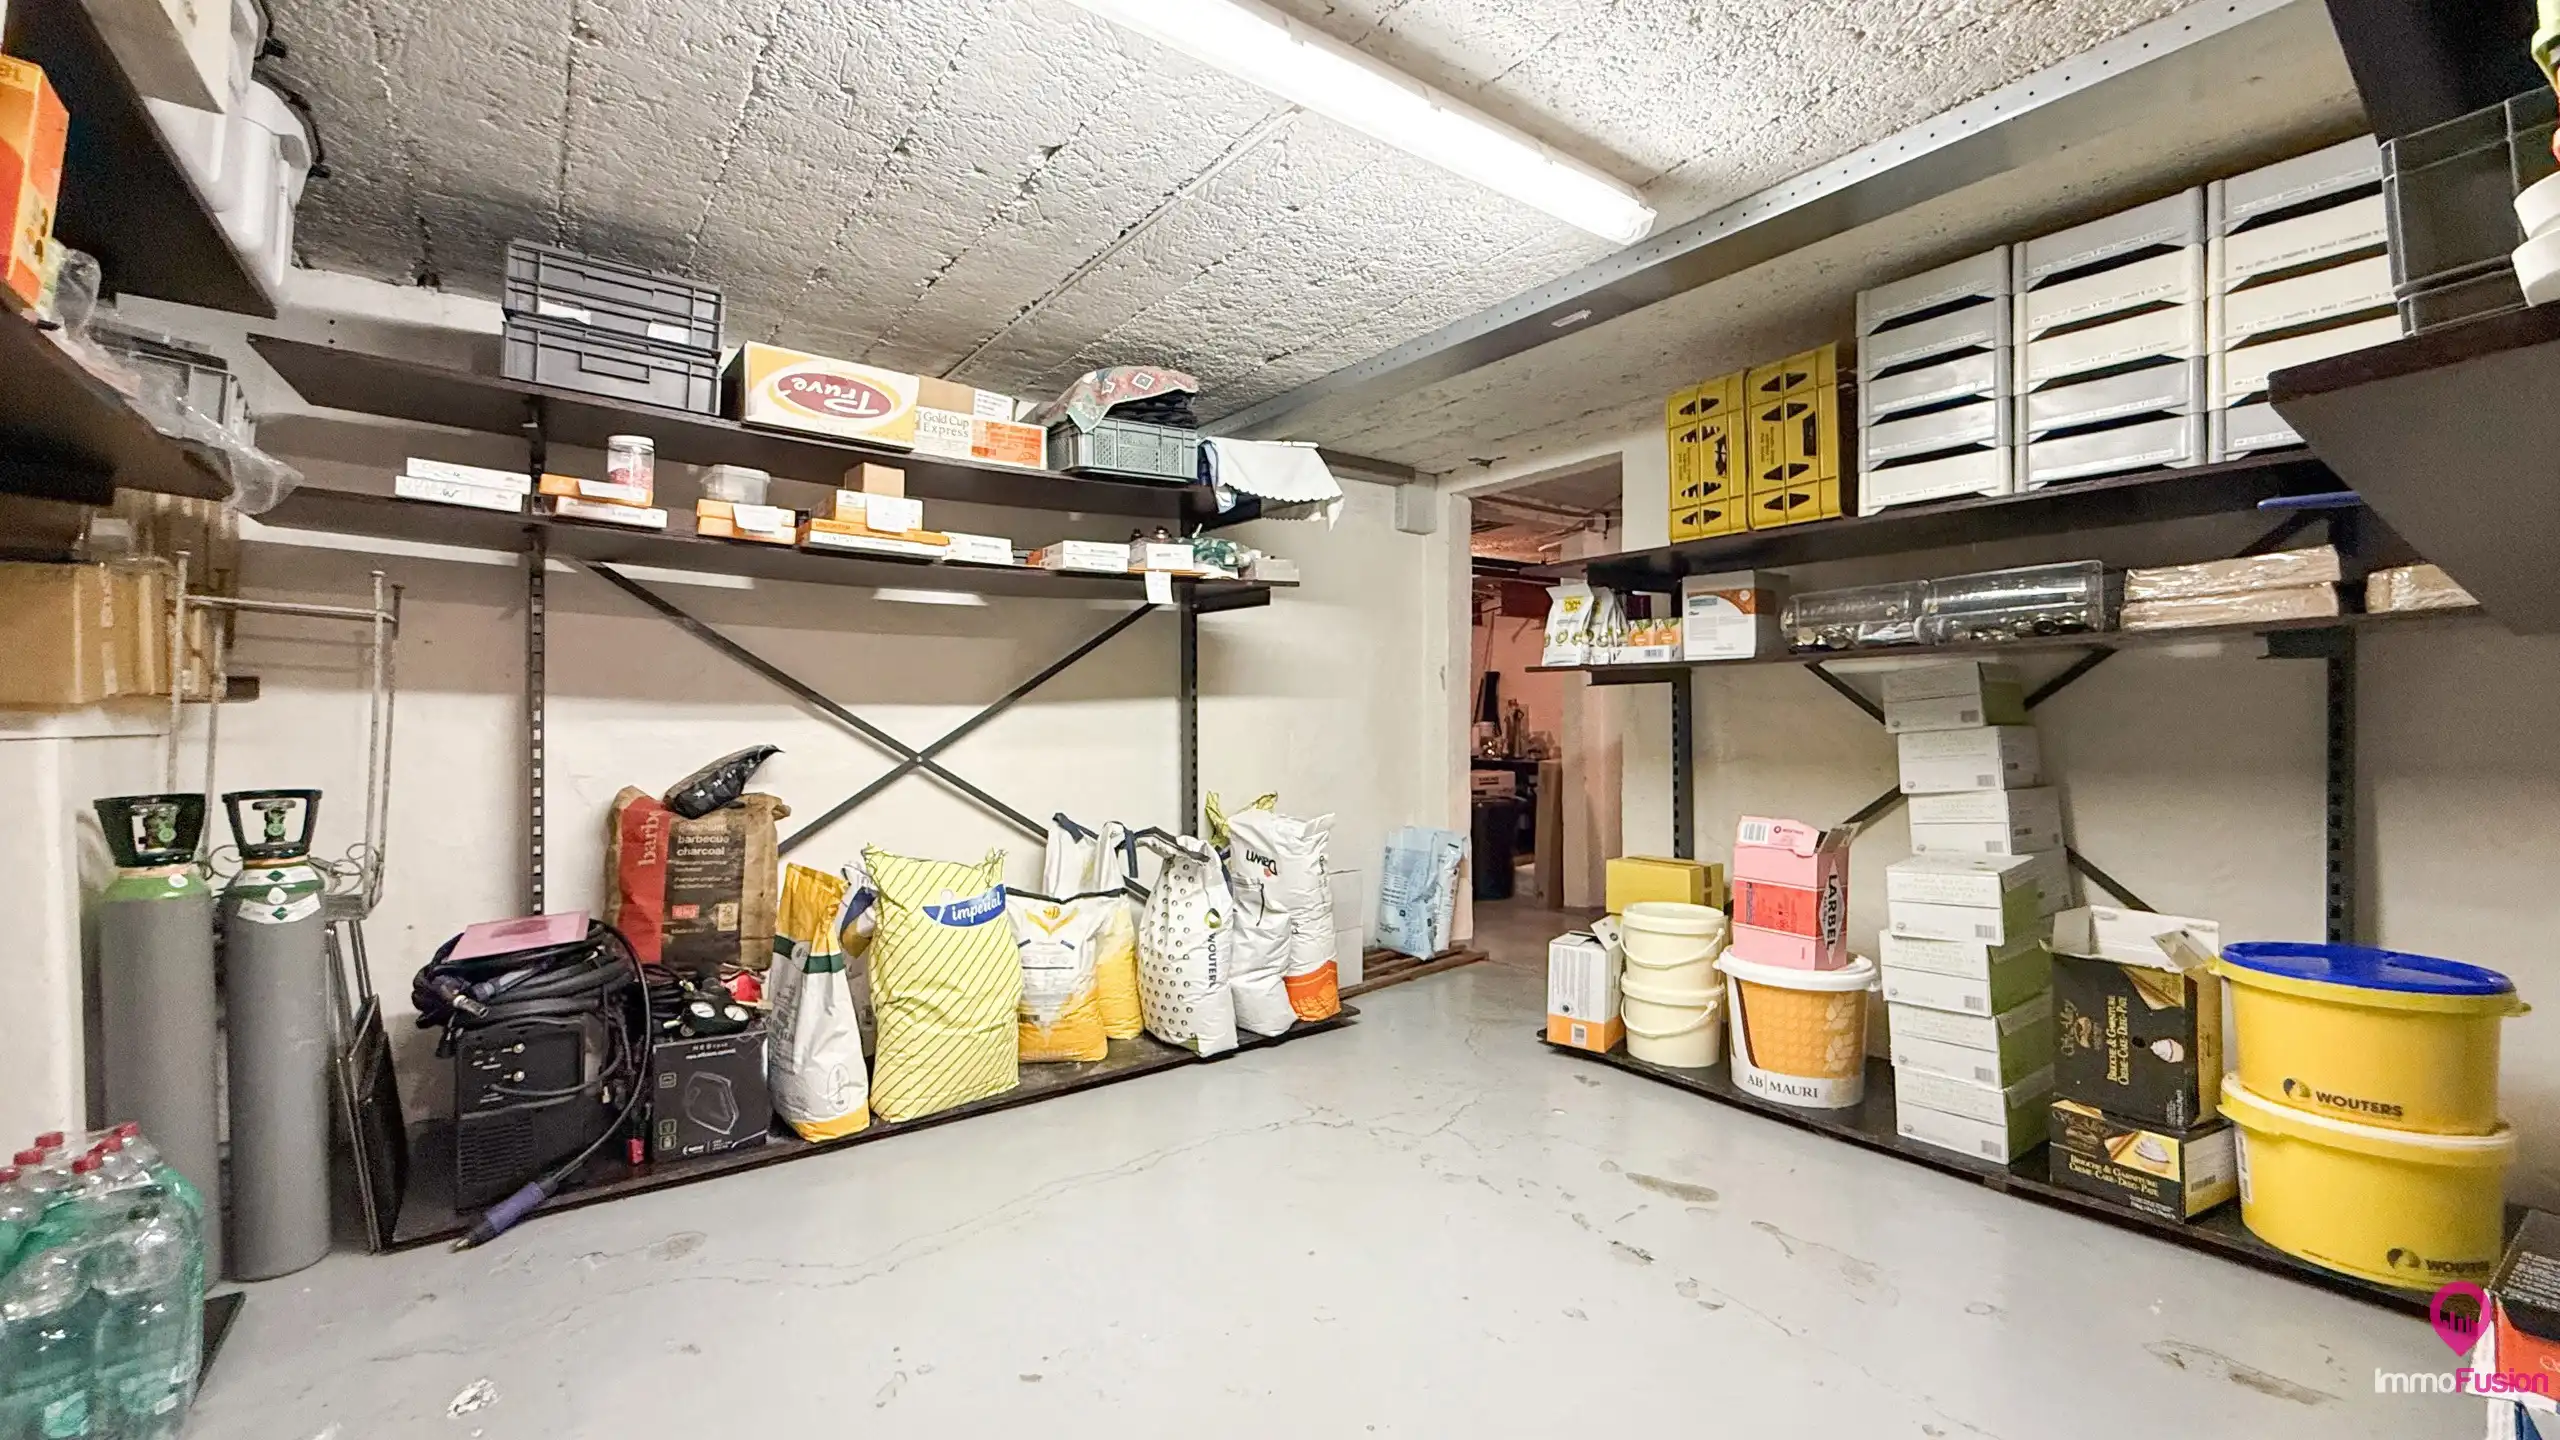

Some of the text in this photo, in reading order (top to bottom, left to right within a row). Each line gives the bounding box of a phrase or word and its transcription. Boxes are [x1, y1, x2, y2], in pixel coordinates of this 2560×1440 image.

[923, 410, 969, 429] Gold Cup
[923, 421, 969, 438] Express
[677, 835, 729, 844] barbecue
[676, 846, 725, 856] charcoal
[952, 891, 1002, 923] imperial
[1826, 874, 1838, 951] LARBEL
[1747, 1074, 1819, 1099] AB MAURI
[2316, 1090, 2403, 1117] WOUTERS
